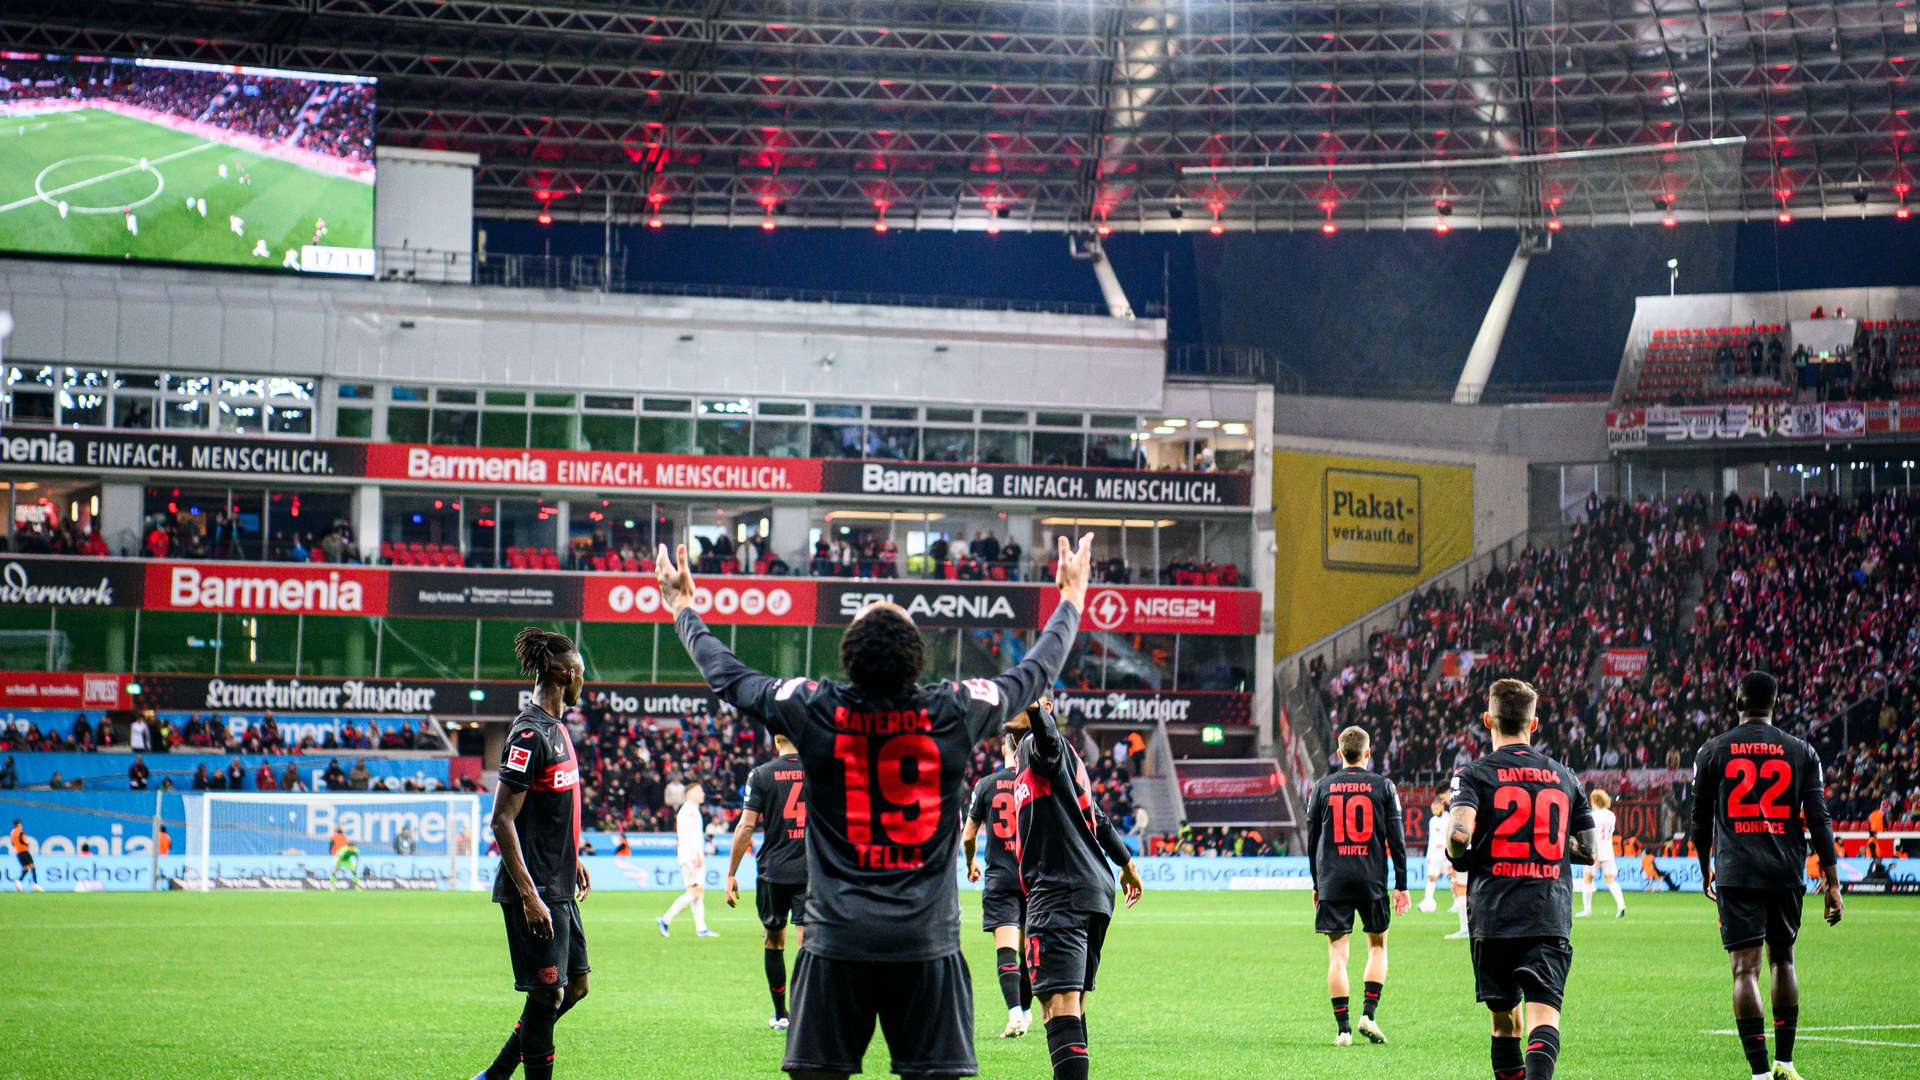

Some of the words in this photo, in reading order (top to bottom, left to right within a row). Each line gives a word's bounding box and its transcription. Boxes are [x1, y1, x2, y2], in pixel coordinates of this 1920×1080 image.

[87, 441, 183, 468] EINFACH.
[191, 446, 335, 474] MENSCHLICH.
[407, 448, 547, 483] Barmenia
[557, 460, 650, 486] EINFACH.
[656, 463, 793, 490] MENSCHLICH.
[862, 463, 994, 496] Barmenia
[1003, 473, 1089, 499] EINFACH.
[1095, 479, 1222, 504] MENSCHLICH.
[1332, 489, 1414, 521] Plakat-
[170, 566, 363, 612] Barmenia
[840, 592, 1016, 619] SARNIA
[1134, 597, 1216, 618] NRG24
[342, 680, 436, 713] Anzeiger
[644, 694, 709, 714] unter:
[783, 781, 807, 828] 4
[833, 734, 943, 845] 19
[1725, 757, 1792, 819] 22
[307, 800, 498, 844] Barmena
[1328, 794, 1374, 843] 10
[1490, 785, 1570, 861] 20
[855, 843, 925, 870] TELLA
[1337, 845, 1369, 856] WIRTZ
[45, 861, 149, 882] sicher
[655, 865, 721, 886] tre
[1492, 861, 1561, 880] GRIMALDO
